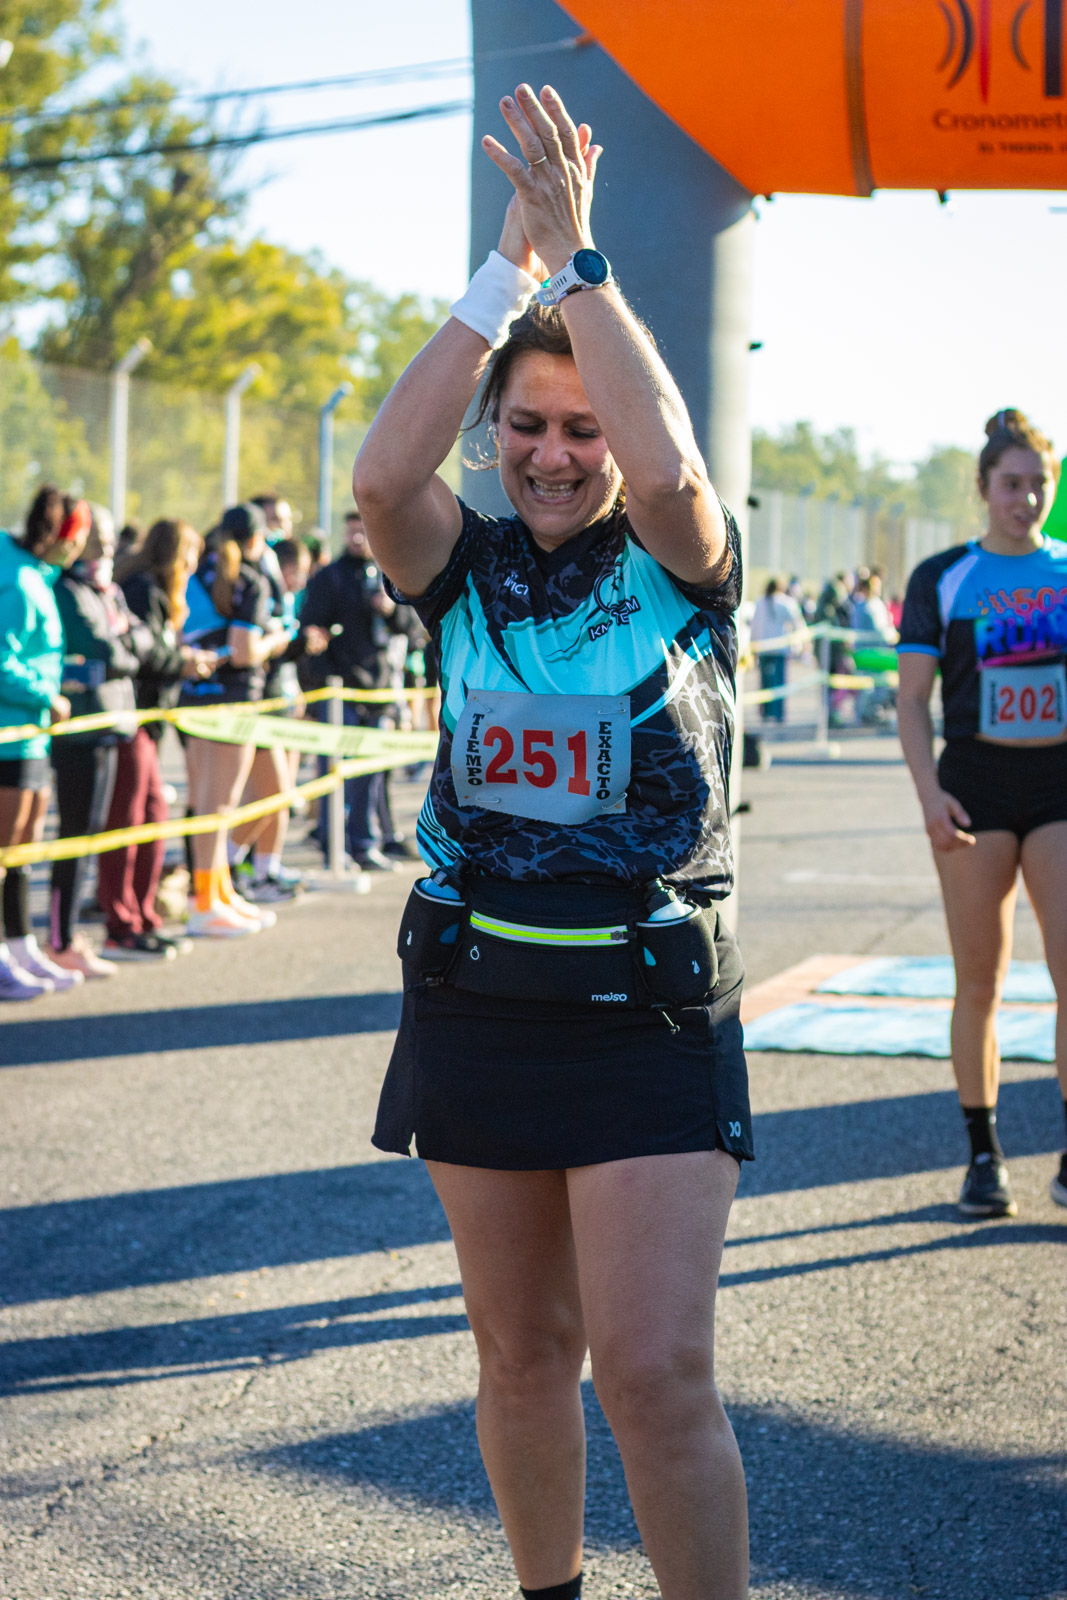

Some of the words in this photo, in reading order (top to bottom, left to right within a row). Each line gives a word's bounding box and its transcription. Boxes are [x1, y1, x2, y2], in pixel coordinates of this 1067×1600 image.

[998, 685, 1056, 722] 202
[466, 713, 485, 786] TIEMPO
[483, 725, 591, 797] 251
[596, 721, 613, 800] EXACTO
